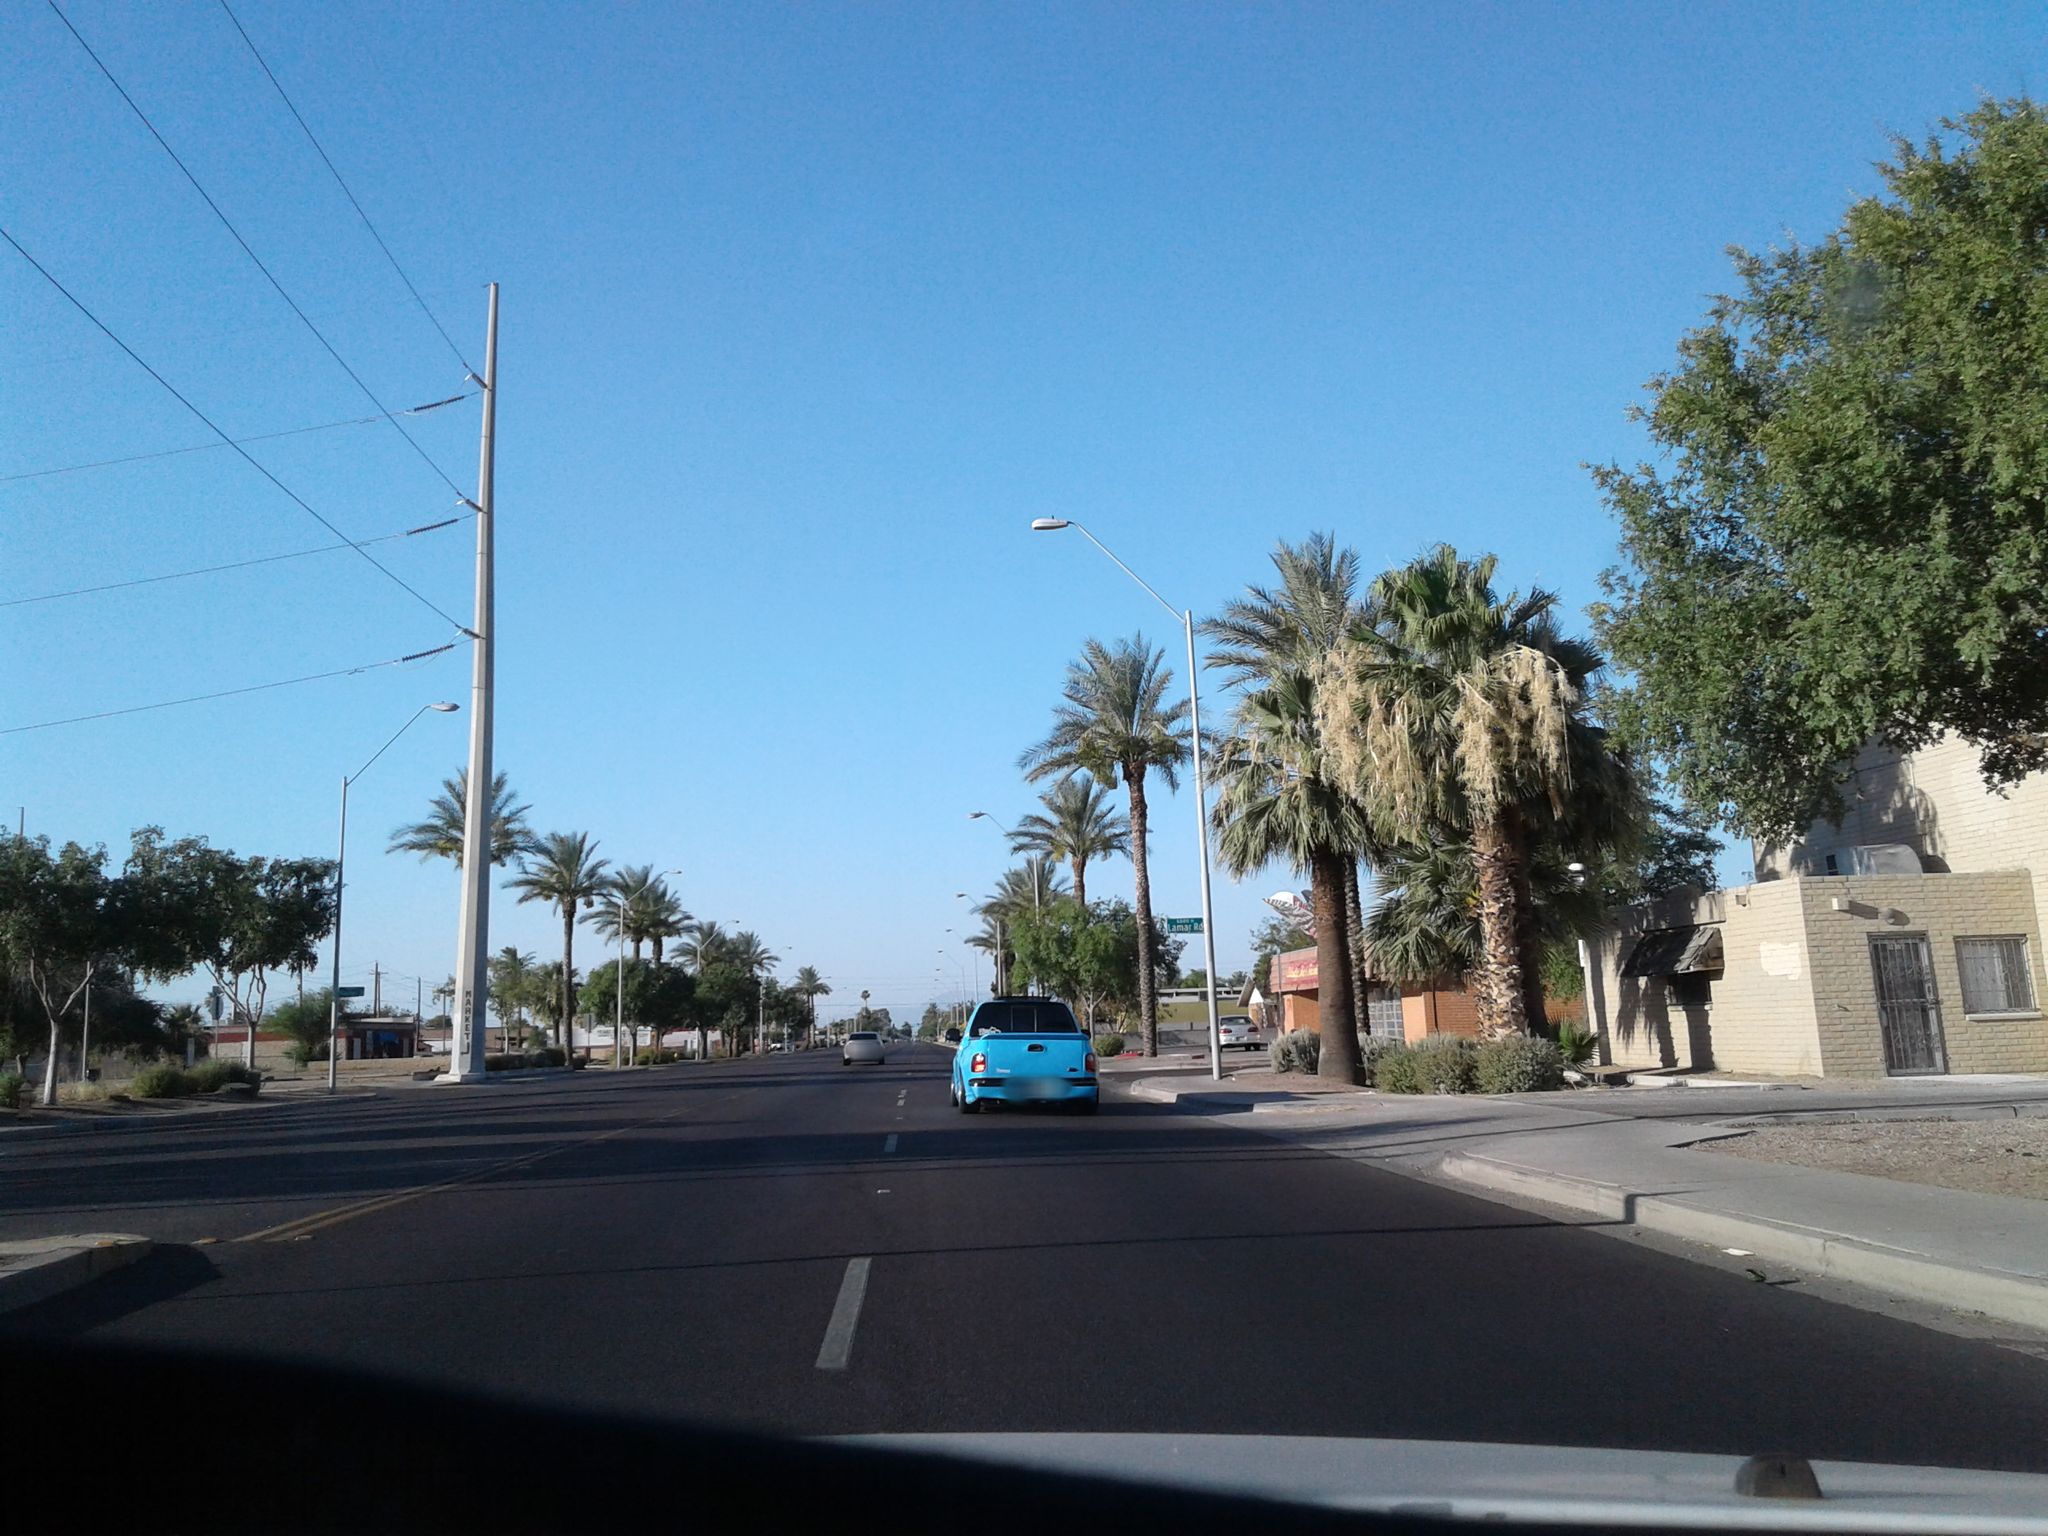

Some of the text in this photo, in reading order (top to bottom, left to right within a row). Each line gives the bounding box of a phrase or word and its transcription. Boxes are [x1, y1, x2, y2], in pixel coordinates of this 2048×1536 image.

[1168, 922, 1204, 933] Lamar Rd
[464, 990, 473, 1041] MARKET
